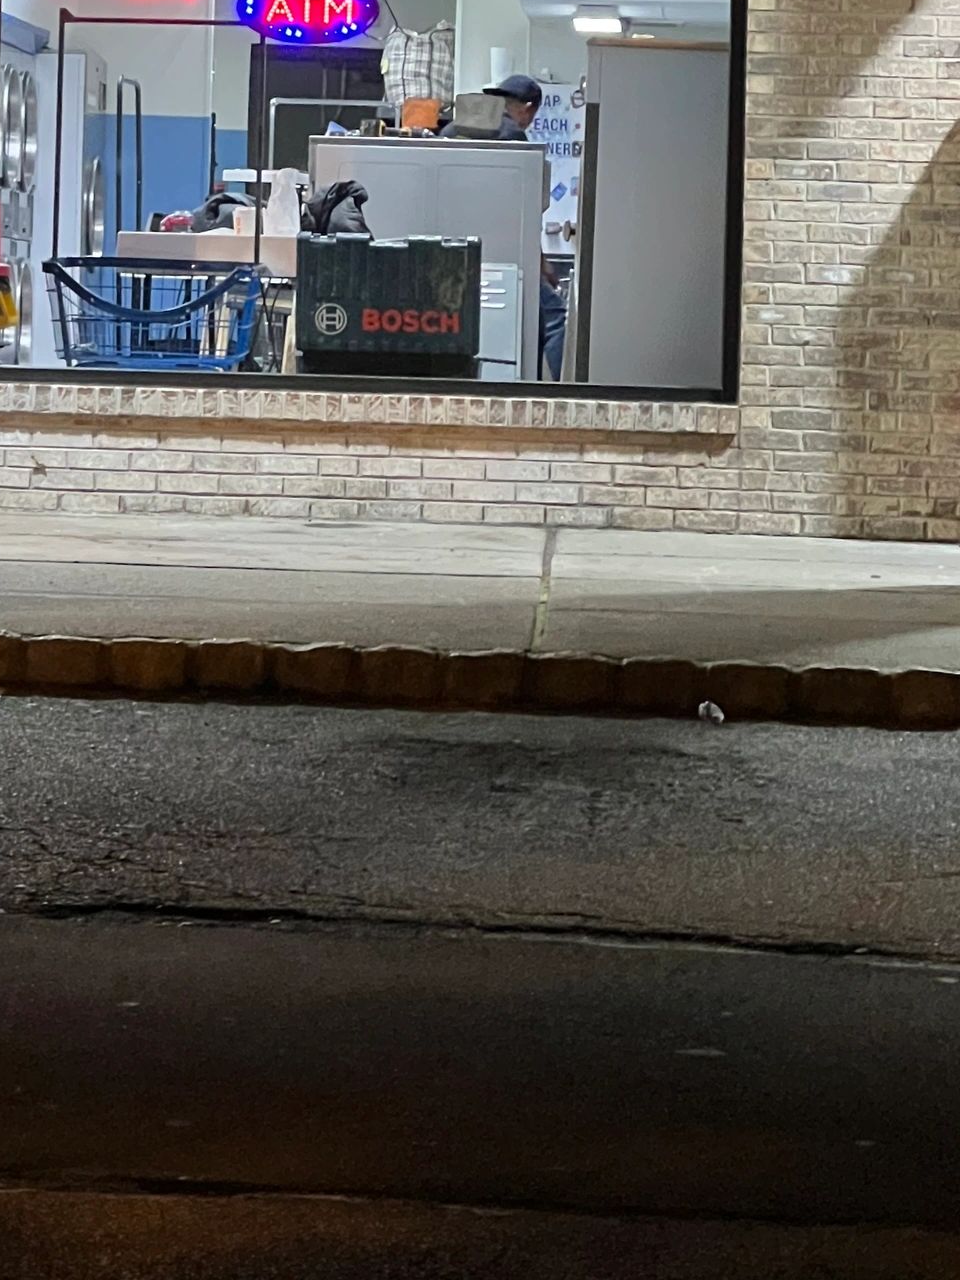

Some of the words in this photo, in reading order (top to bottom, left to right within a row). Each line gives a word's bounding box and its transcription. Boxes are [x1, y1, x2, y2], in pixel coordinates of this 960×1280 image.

[543, 94, 561, 107] AP
[533, 118, 568, 131] EACH
[361, 308, 460, 334] BOSCH
